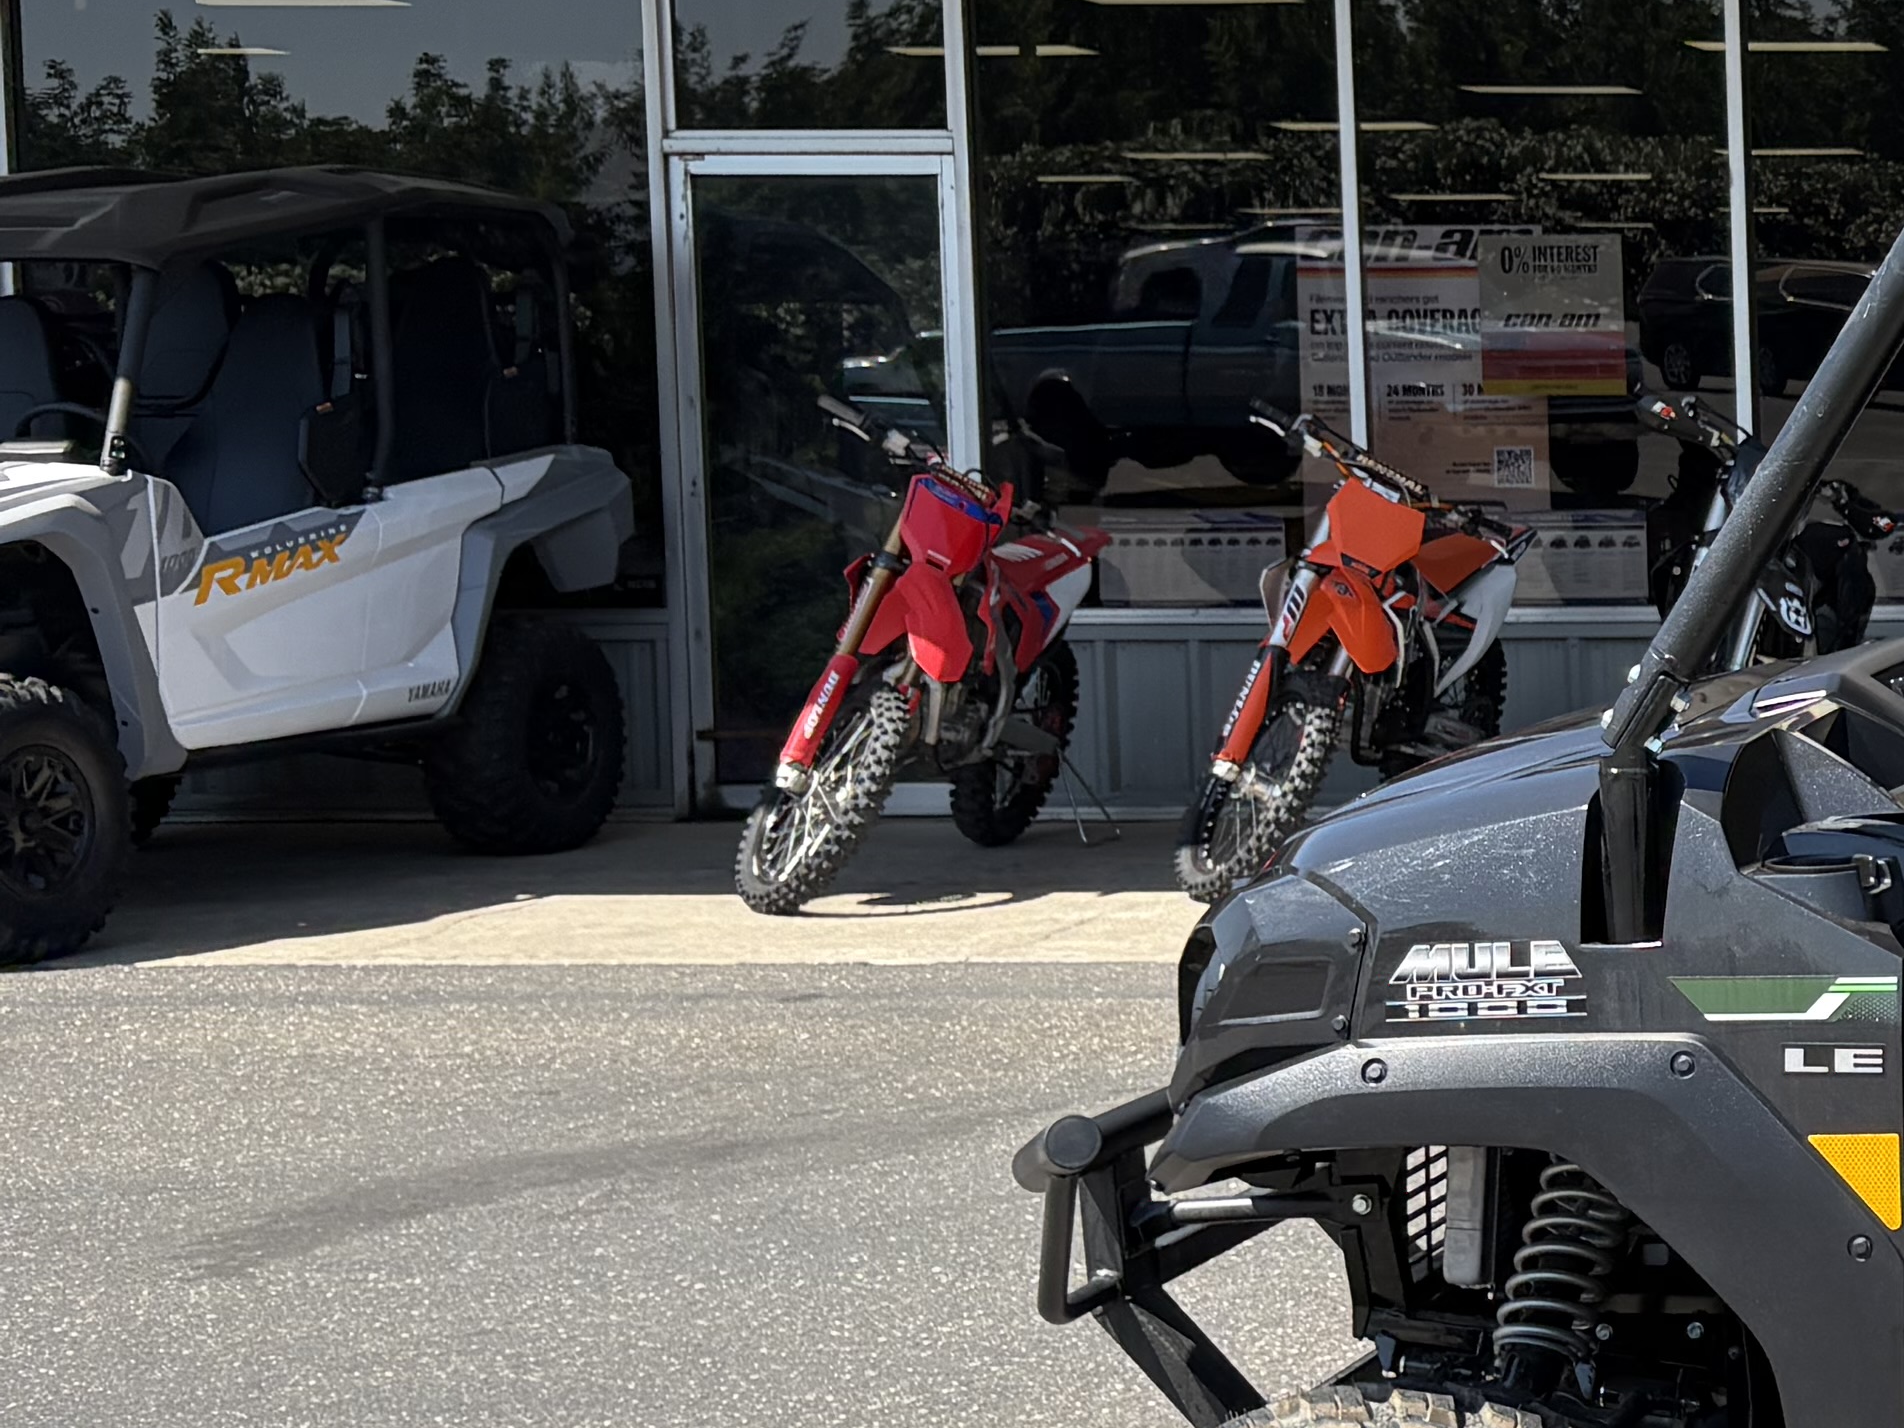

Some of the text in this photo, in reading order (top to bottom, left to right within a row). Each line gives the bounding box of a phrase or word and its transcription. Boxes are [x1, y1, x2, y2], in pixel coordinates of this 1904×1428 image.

[1500, 244, 1600, 274] 0% INTEREST
[250, 523, 348, 559] WOLVERINE
[193, 532, 349, 608] RMAX
[407, 678, 452, 703] YAMAHA
[804, 669, 841, 740] DUNLOP
[1388, 939, 1583, 985] MULE
[1406, 978, 1565, 1000] PRO-FXT
[1405, 1000, 1568, 1019] 1000
[1784, 1047, 1884, 1073] LE
